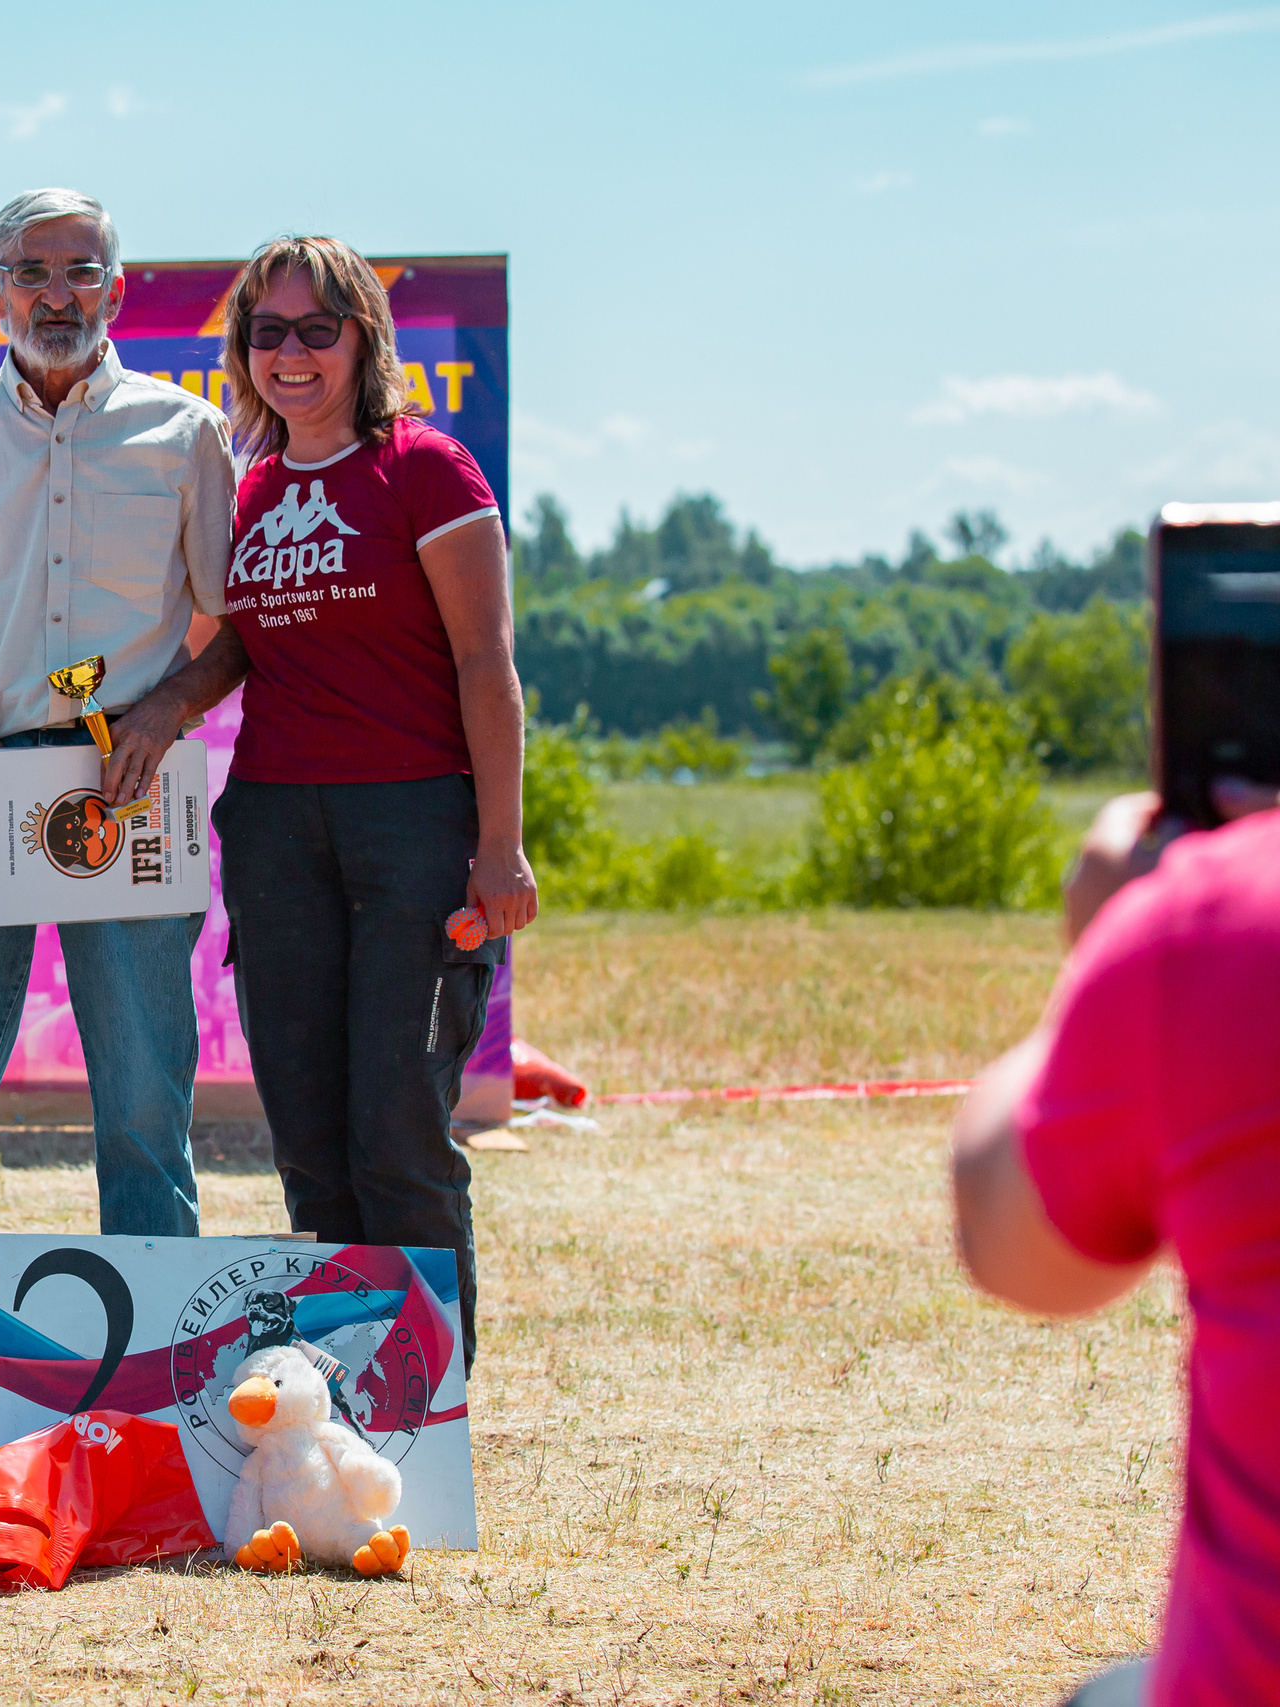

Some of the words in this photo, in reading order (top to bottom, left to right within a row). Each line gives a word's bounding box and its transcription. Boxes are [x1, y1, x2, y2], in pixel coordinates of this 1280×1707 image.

[227, 538, 347, 590] Kappa
[260, 588, 325, 609] Sportswear
[330, 583, 376, 600] Brand
[258, 613, 291, 628] Since
[292, 607, 318, 623] 1967
[148, 773, 161, 805] SHOW
[149, 808, 161, 829] DOG
[186, 795, 194, 842] TABOOSPORT
[131, 835, 163, 886] IFR
[164, 850, 172, 864] MAY
[177, 1260, 266, 1429] РОТВЕЙЛЕР
[285, 1257, 372, 1298] КЛУБ
[379, 1306, 425, 1437] РОССИИ
